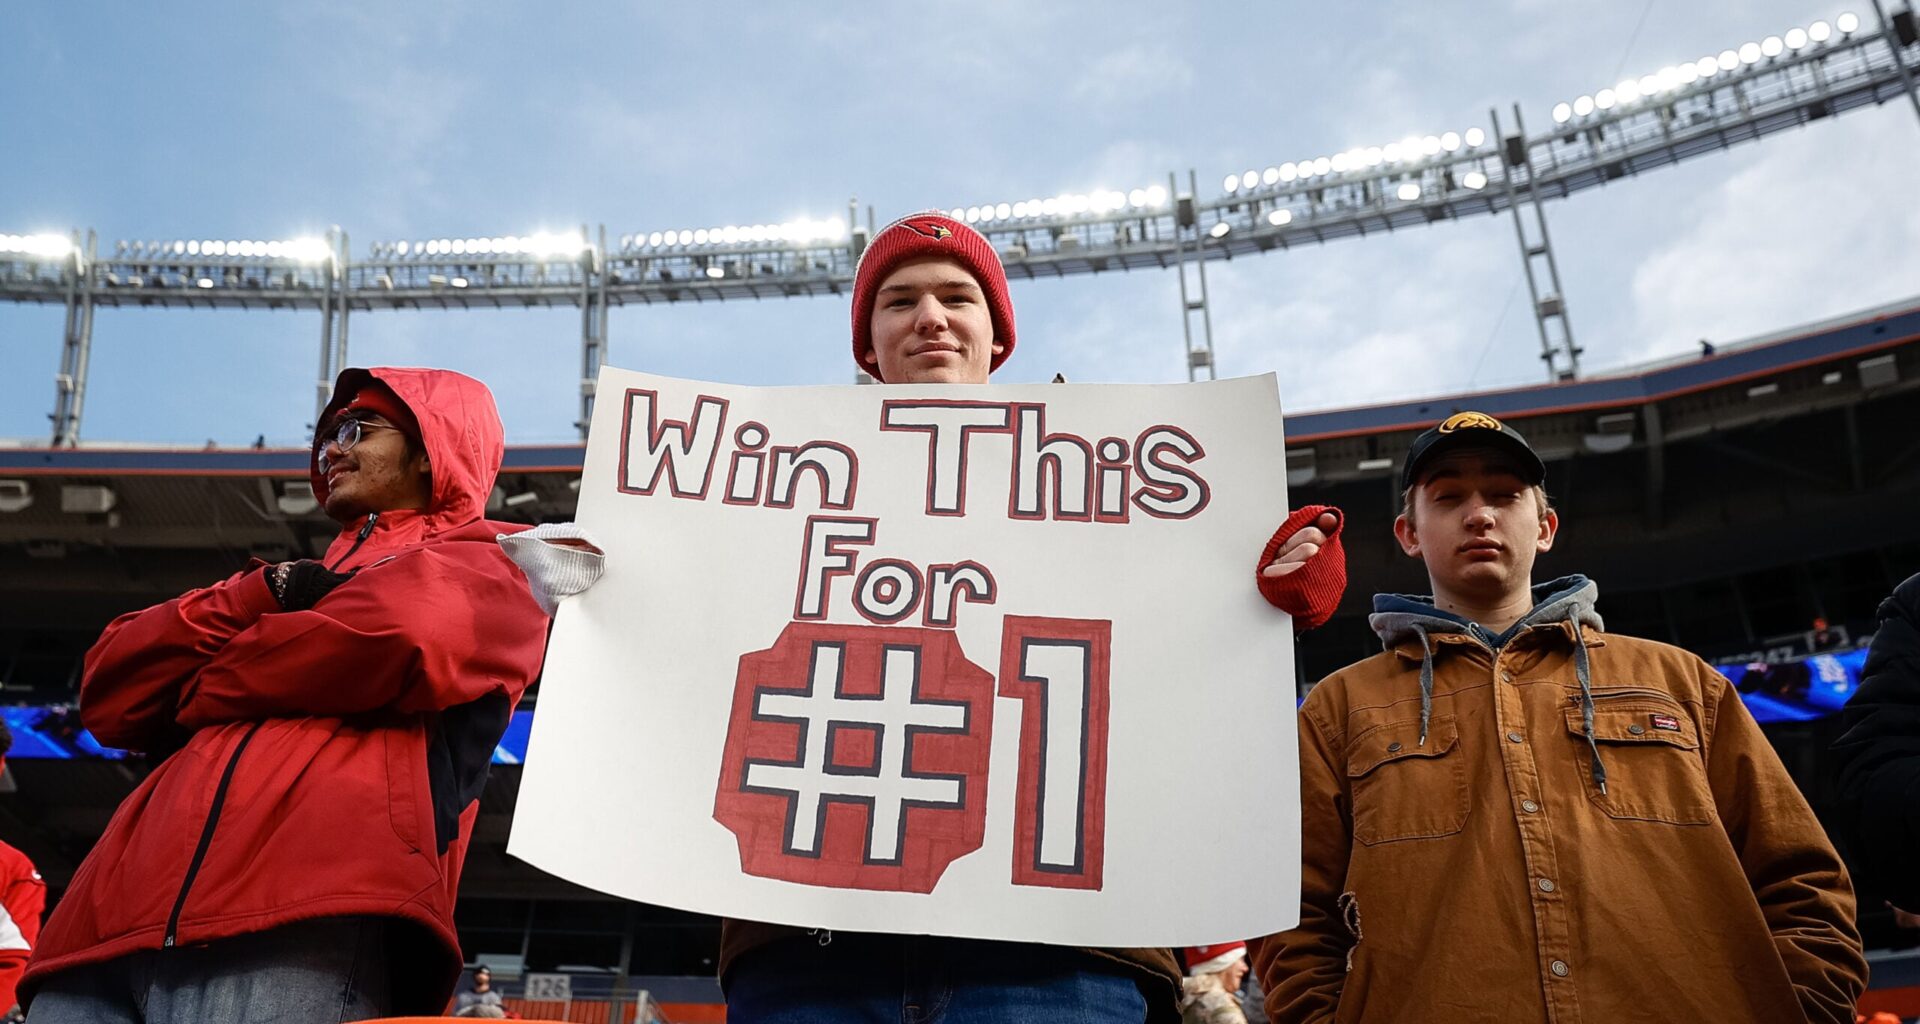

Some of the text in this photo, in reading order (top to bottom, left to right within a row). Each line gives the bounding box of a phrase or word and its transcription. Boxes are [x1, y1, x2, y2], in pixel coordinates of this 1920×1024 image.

[617, 388, 1211, 524] Win This
[793, 515, 997, 628] For
[712, 614, 1112, 894] #1
[532, 977, 567, 998] 126
